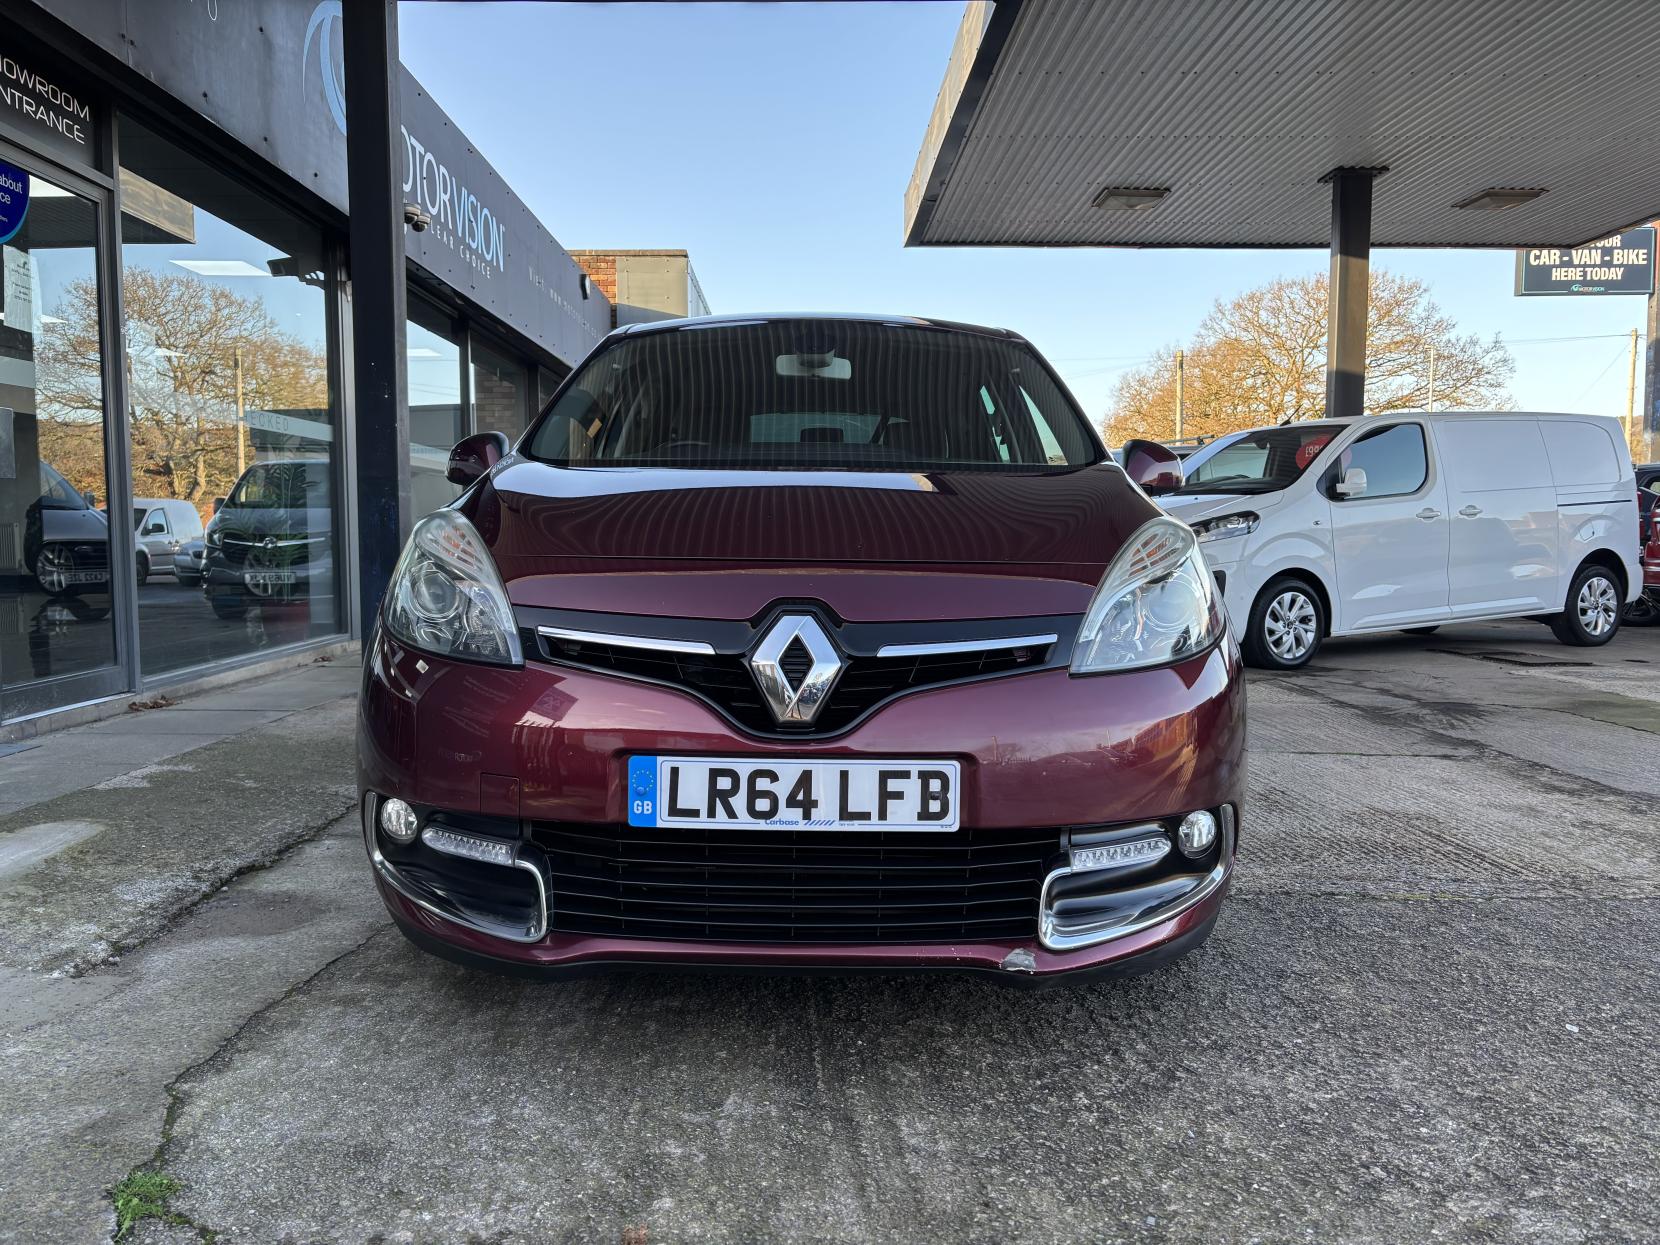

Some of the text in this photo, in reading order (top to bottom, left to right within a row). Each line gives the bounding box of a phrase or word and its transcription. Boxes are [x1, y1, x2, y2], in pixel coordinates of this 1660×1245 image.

[430, 219, 491, 279] LEAR CHOICE
[1529, 249, 1560, 266] CAR
[1571, 249, 1601, 265] VAN
[1613, 249, 1648, 265] BIKE
[1551, 267, 1624, 281] HERE TODAY
[667, 766, 950, 821] LR64 LFB
[633, 800, 653, 815] GB
[764, 819, 800, 827] Carbase
